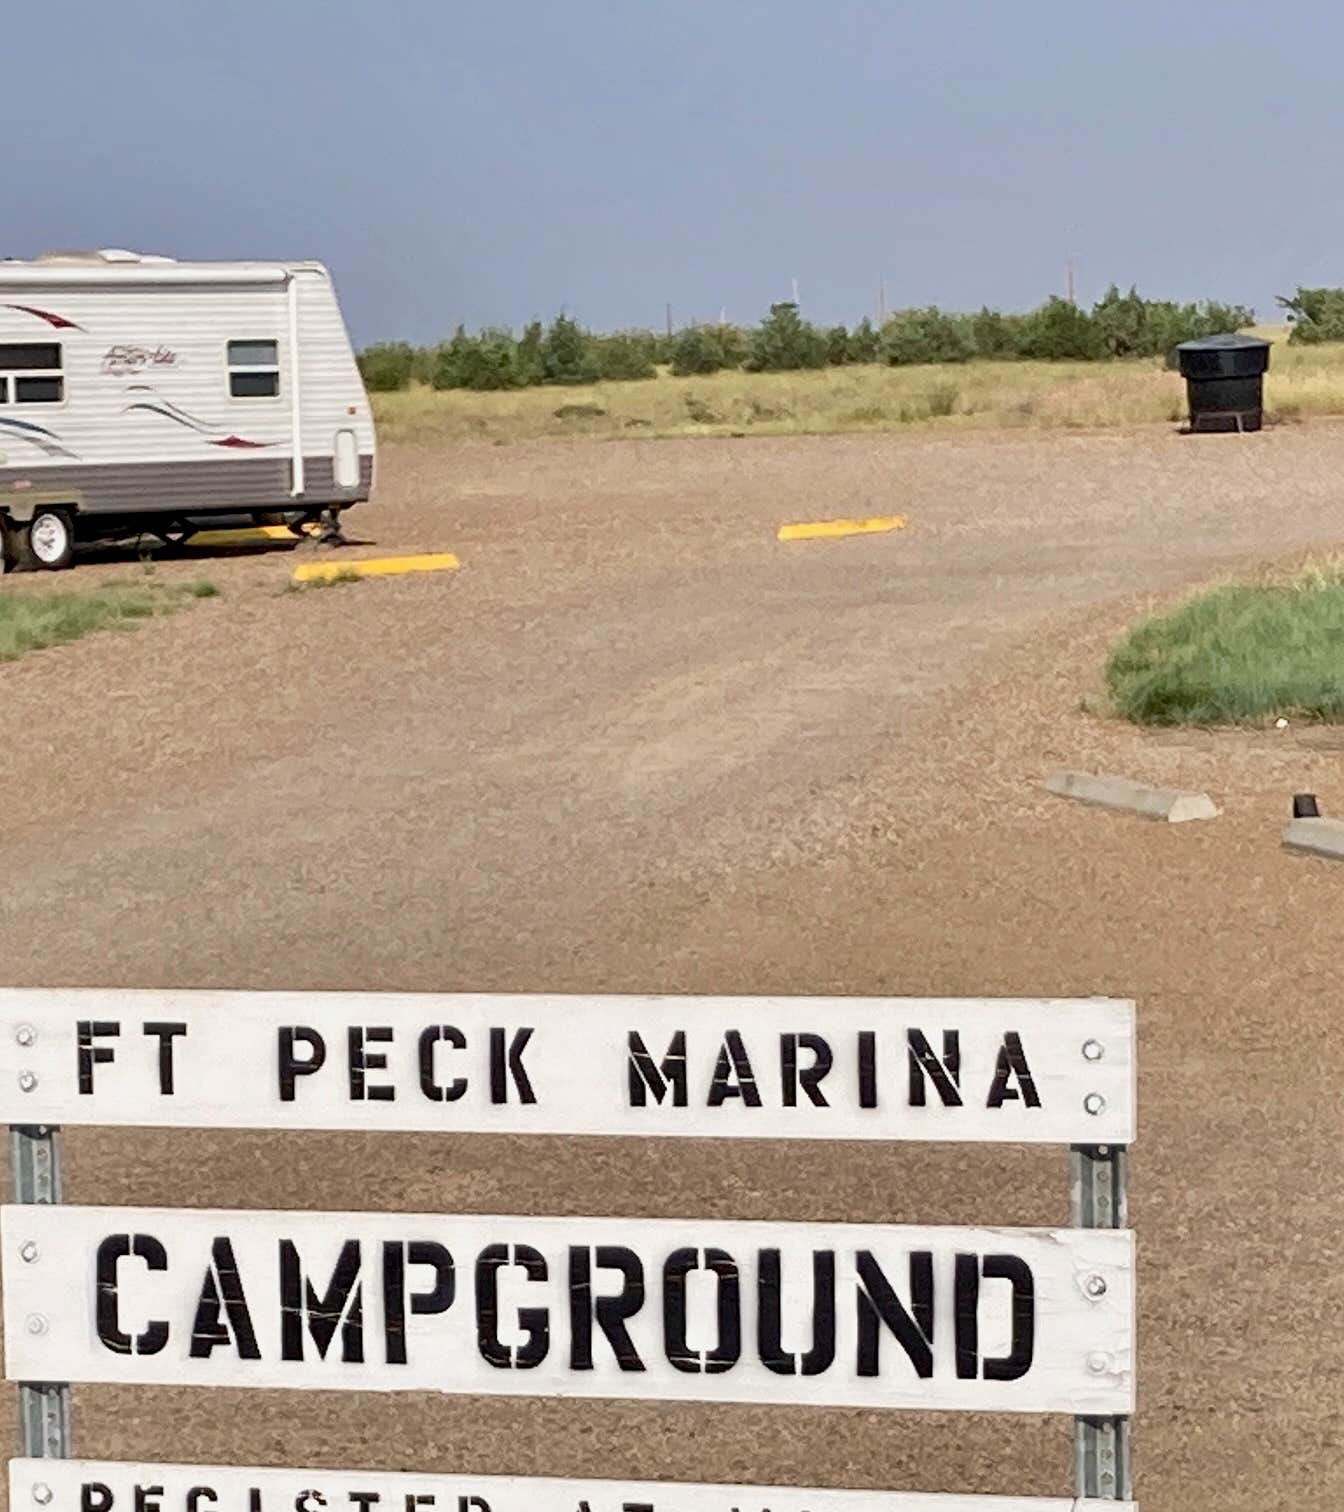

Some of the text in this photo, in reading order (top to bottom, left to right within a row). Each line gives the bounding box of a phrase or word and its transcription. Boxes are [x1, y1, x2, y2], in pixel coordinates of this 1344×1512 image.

[77, 1021, 1042, 1109] FT PECK MARINA
[96, 1233, 1037, 1382] CAMPGROUND
